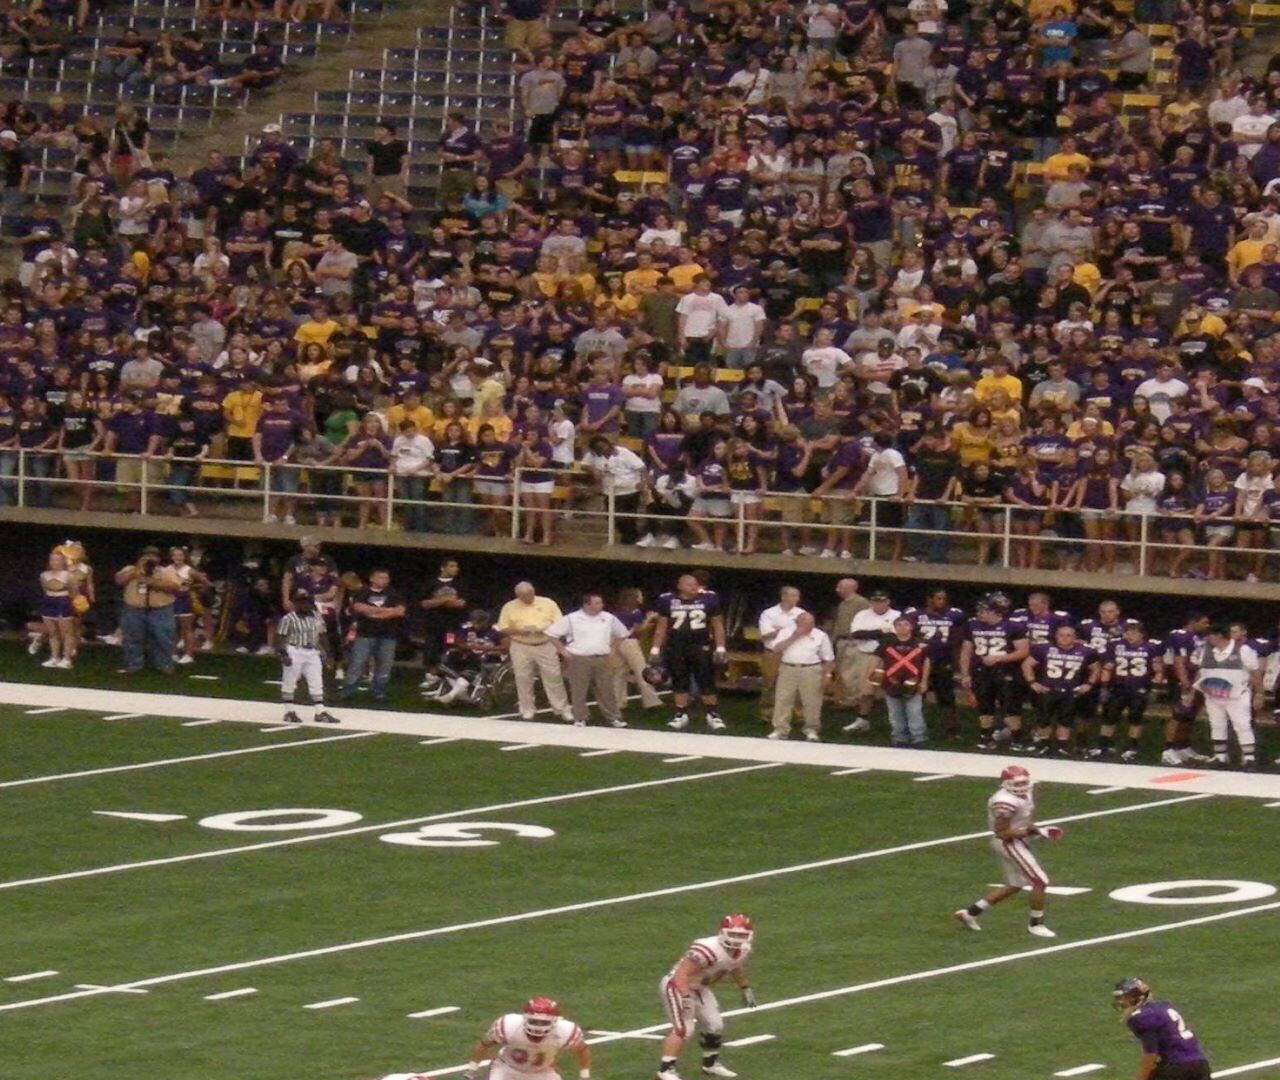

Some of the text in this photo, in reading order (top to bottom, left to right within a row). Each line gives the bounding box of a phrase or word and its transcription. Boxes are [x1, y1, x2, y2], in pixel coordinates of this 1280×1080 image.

[670, 610, 707, 630] 72
[1047, 660, 1083, 680] 57
[1115, 657, 1148, 676] 23
[1167, 1008, 1194, 1039] 2
